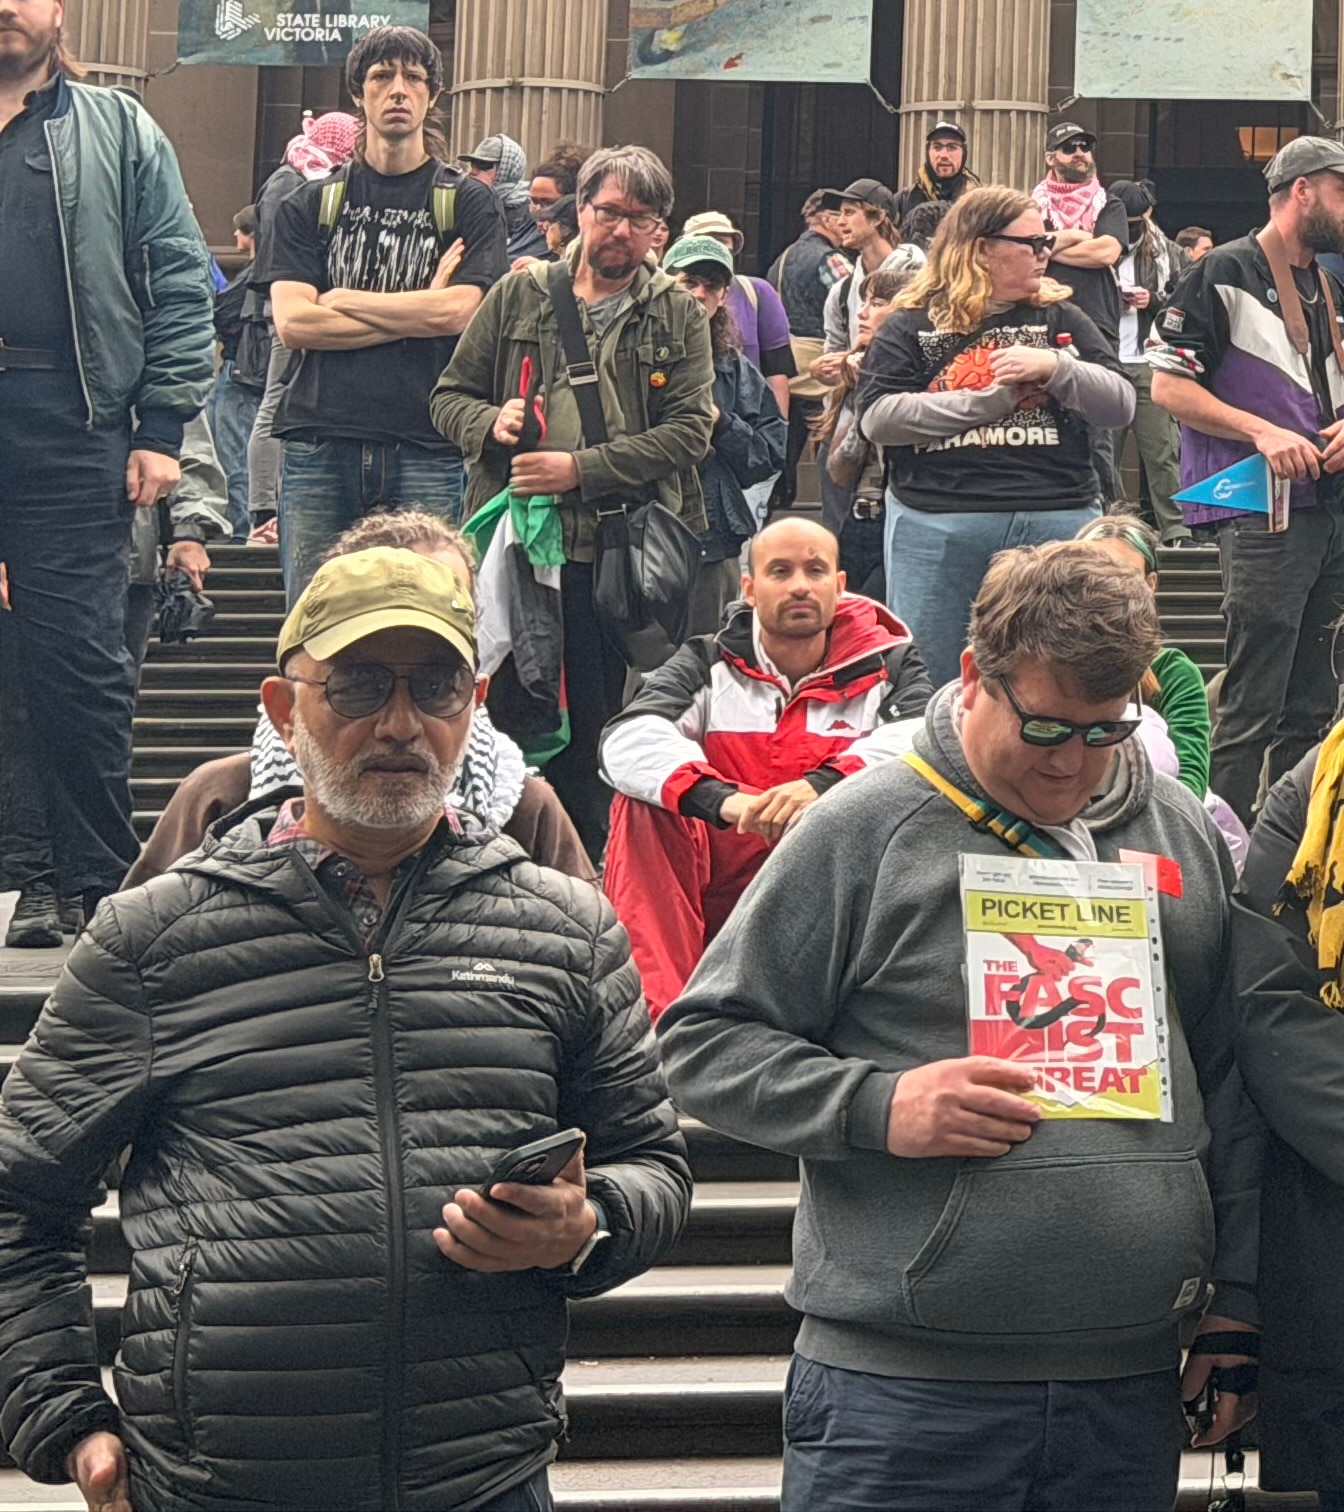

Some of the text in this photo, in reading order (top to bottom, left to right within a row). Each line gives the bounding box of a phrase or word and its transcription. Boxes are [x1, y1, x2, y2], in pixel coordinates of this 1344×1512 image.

[276, 13, 392, 29] STATE LIBRARY
[263, 27, 343, 42] VICTORIA
[981, 897, 1133, 925] PICKET LINE
[983, 959, 1018, 973] THE
[451, 970, 515, 985] Kathmandu
[983, 972, 1143, 1020] FASC
